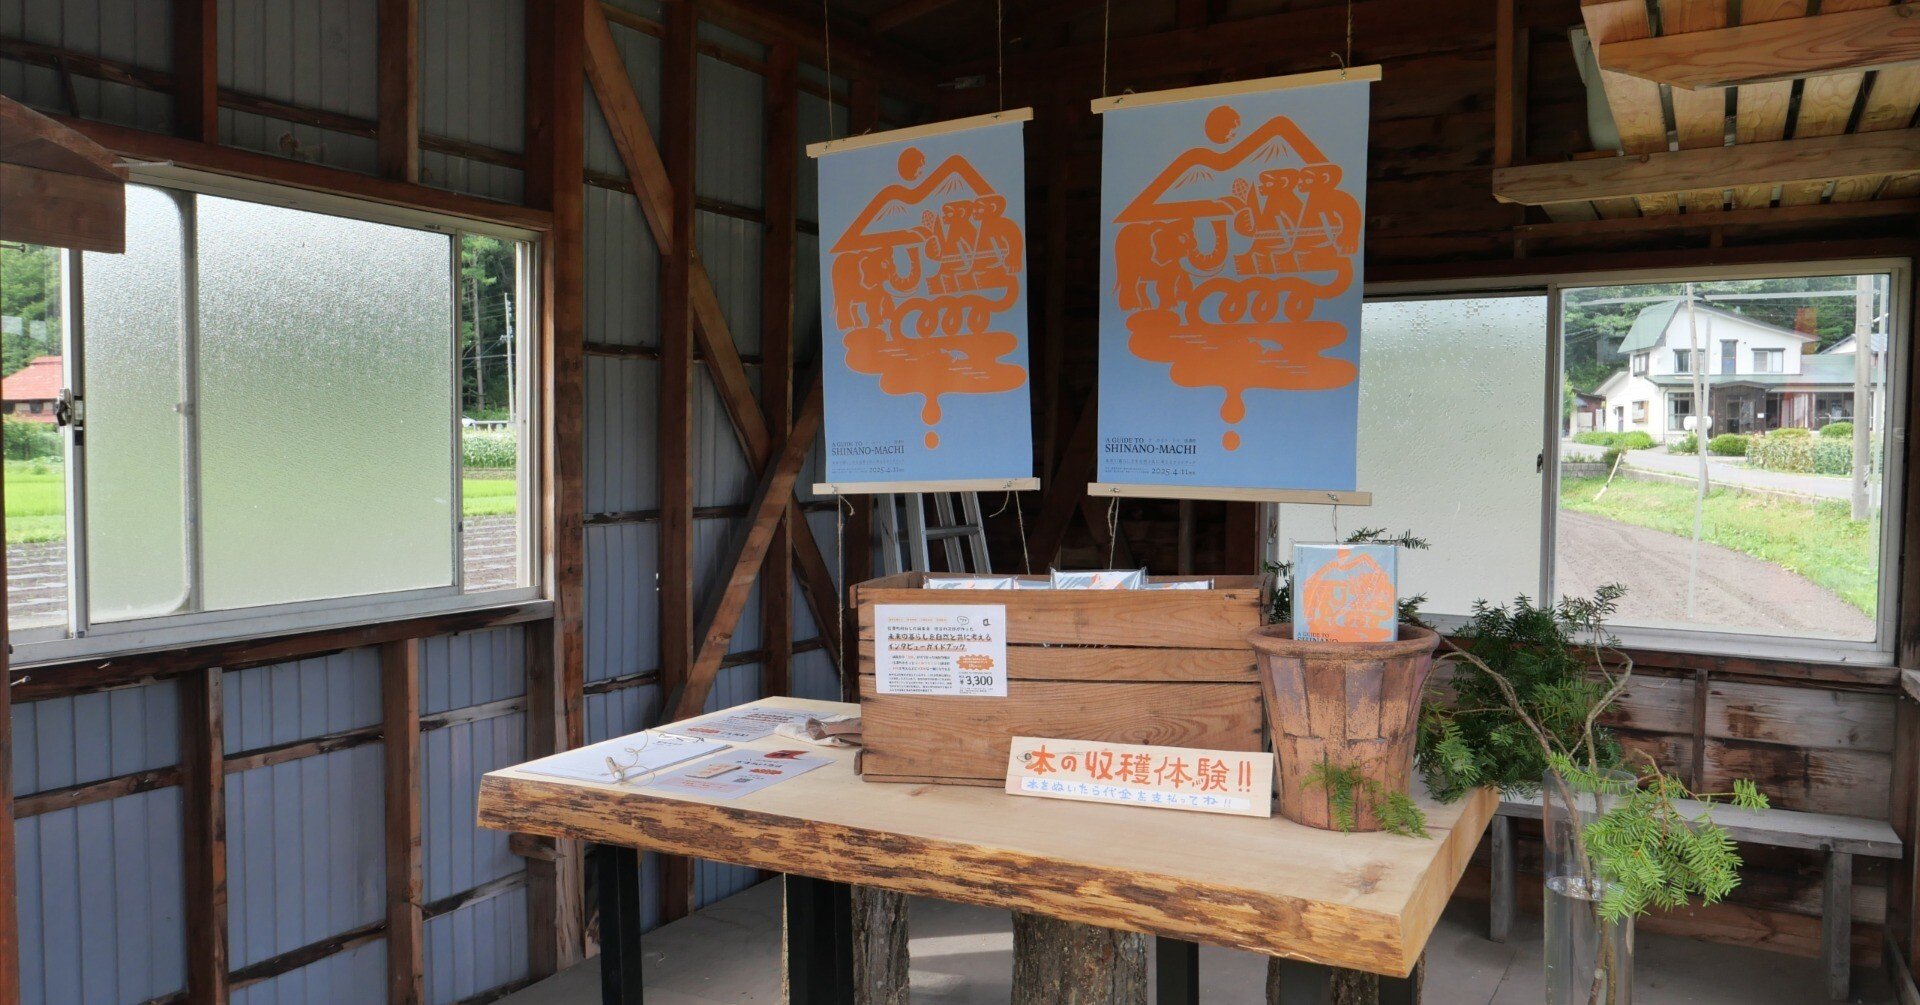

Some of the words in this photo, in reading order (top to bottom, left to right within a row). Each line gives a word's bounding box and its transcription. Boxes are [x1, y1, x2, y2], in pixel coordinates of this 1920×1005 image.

[831, 445, 904, 456] SHINANO-MACHI
[1105, 444, 1196, 454] SHINANO-MACHI
[888, 643, 965, 651] インタビューガイドブック
